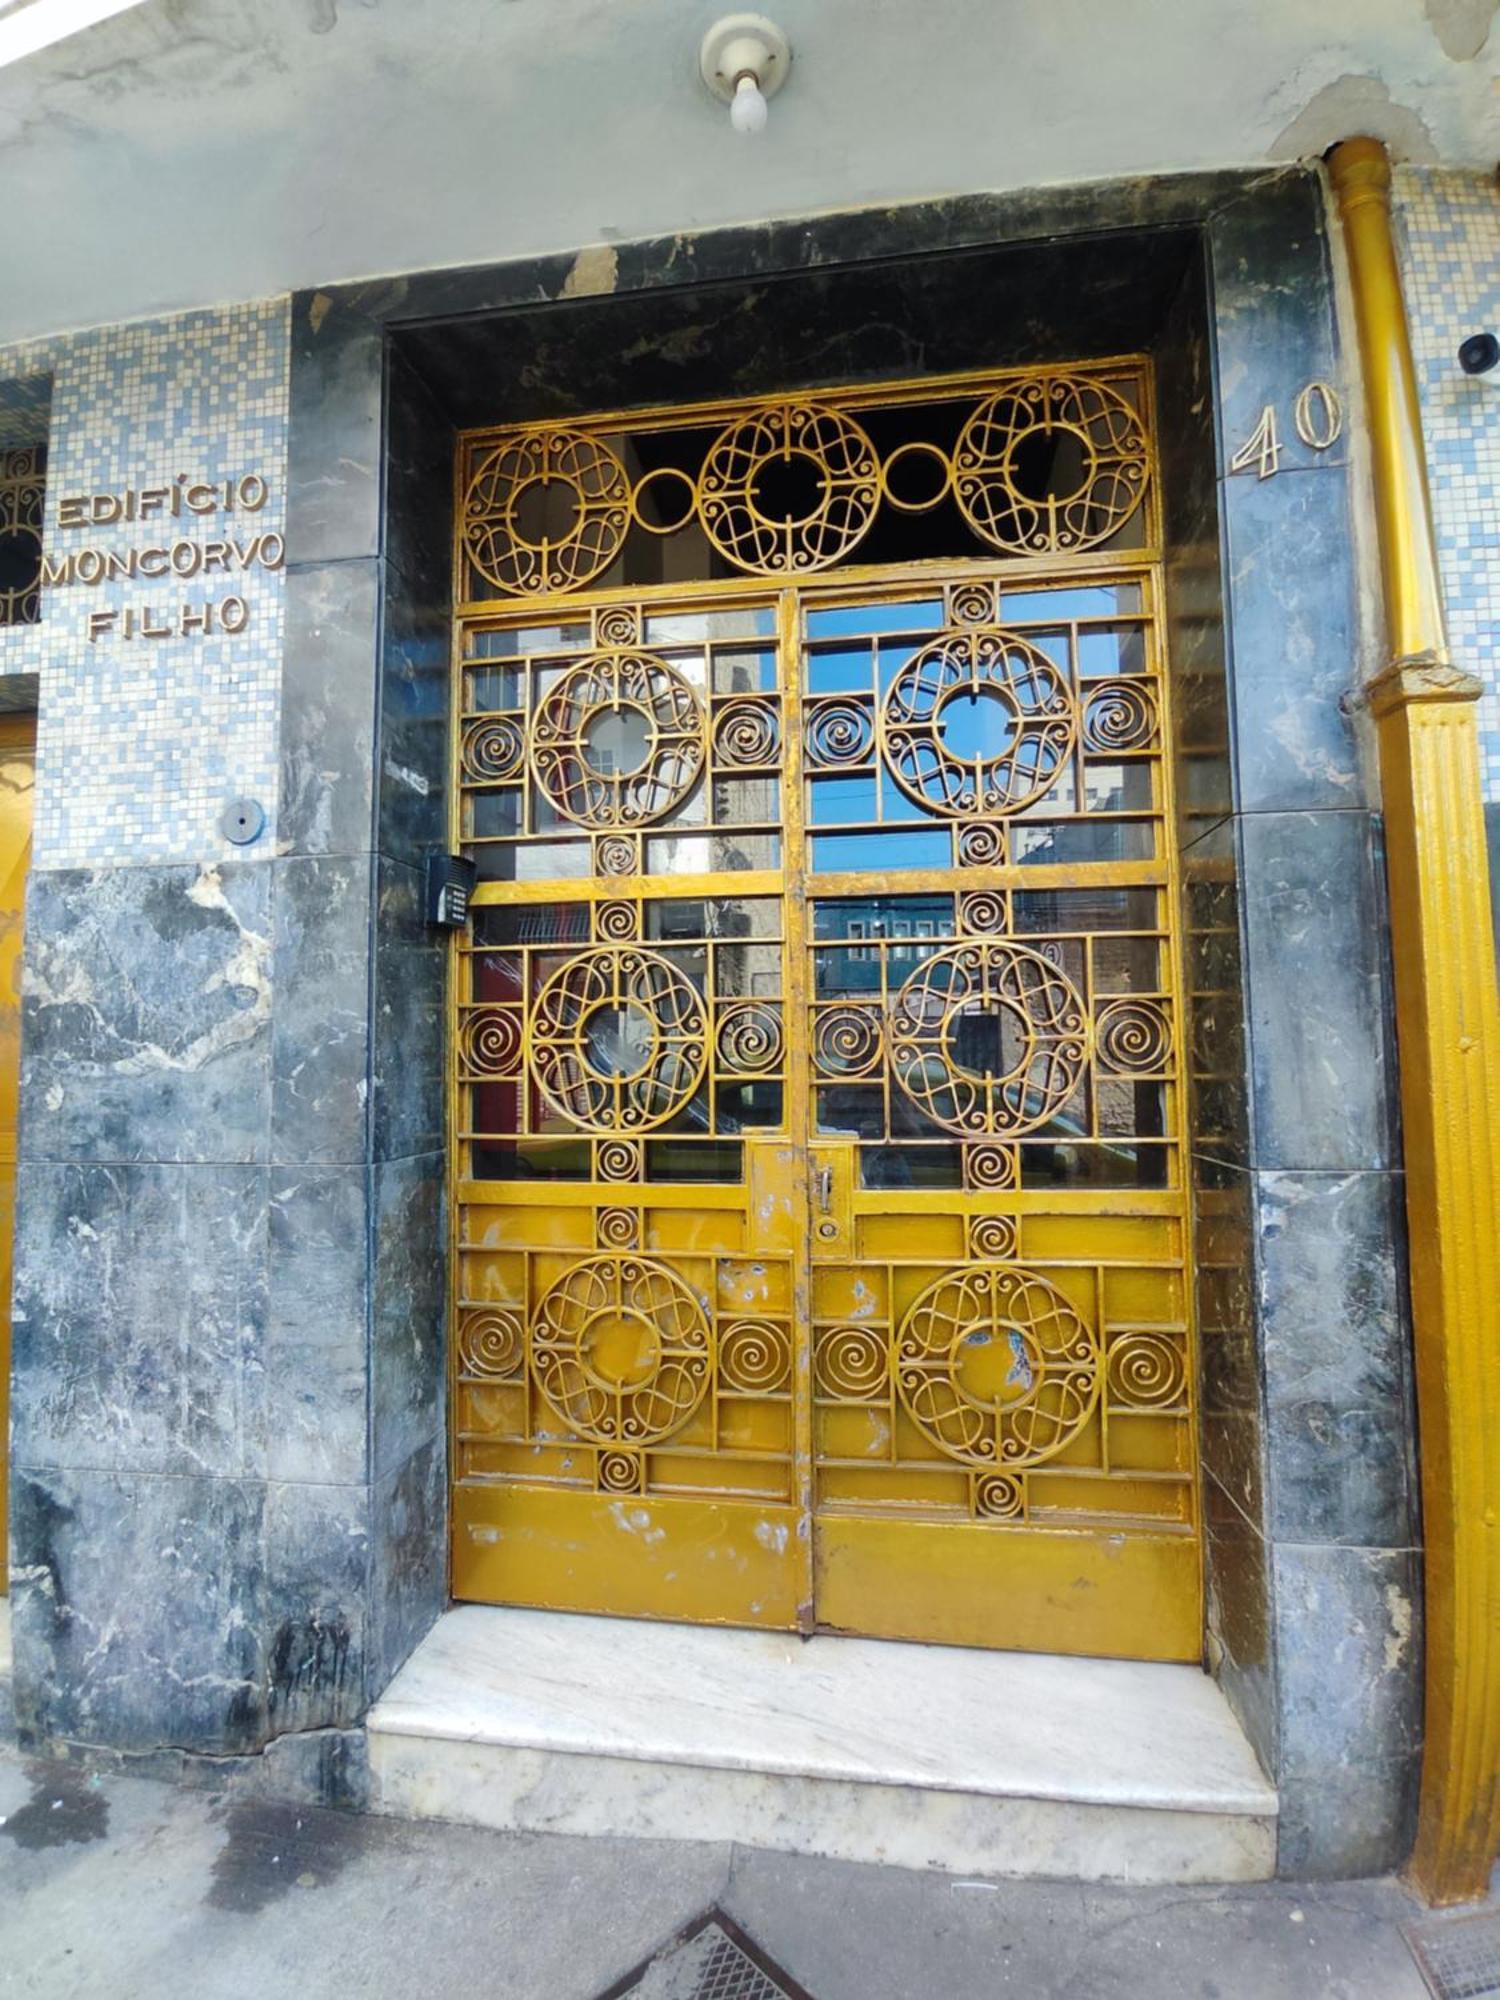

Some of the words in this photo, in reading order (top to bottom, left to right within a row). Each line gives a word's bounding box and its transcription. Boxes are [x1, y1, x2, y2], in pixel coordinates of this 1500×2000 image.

[1231, 382, 1343, 481] 40
[57, 473, 268, 529] EDIFÍCIO
[40, 532, 285, 587] MONCORVO
[87, 595, 249, 643] FILHO
